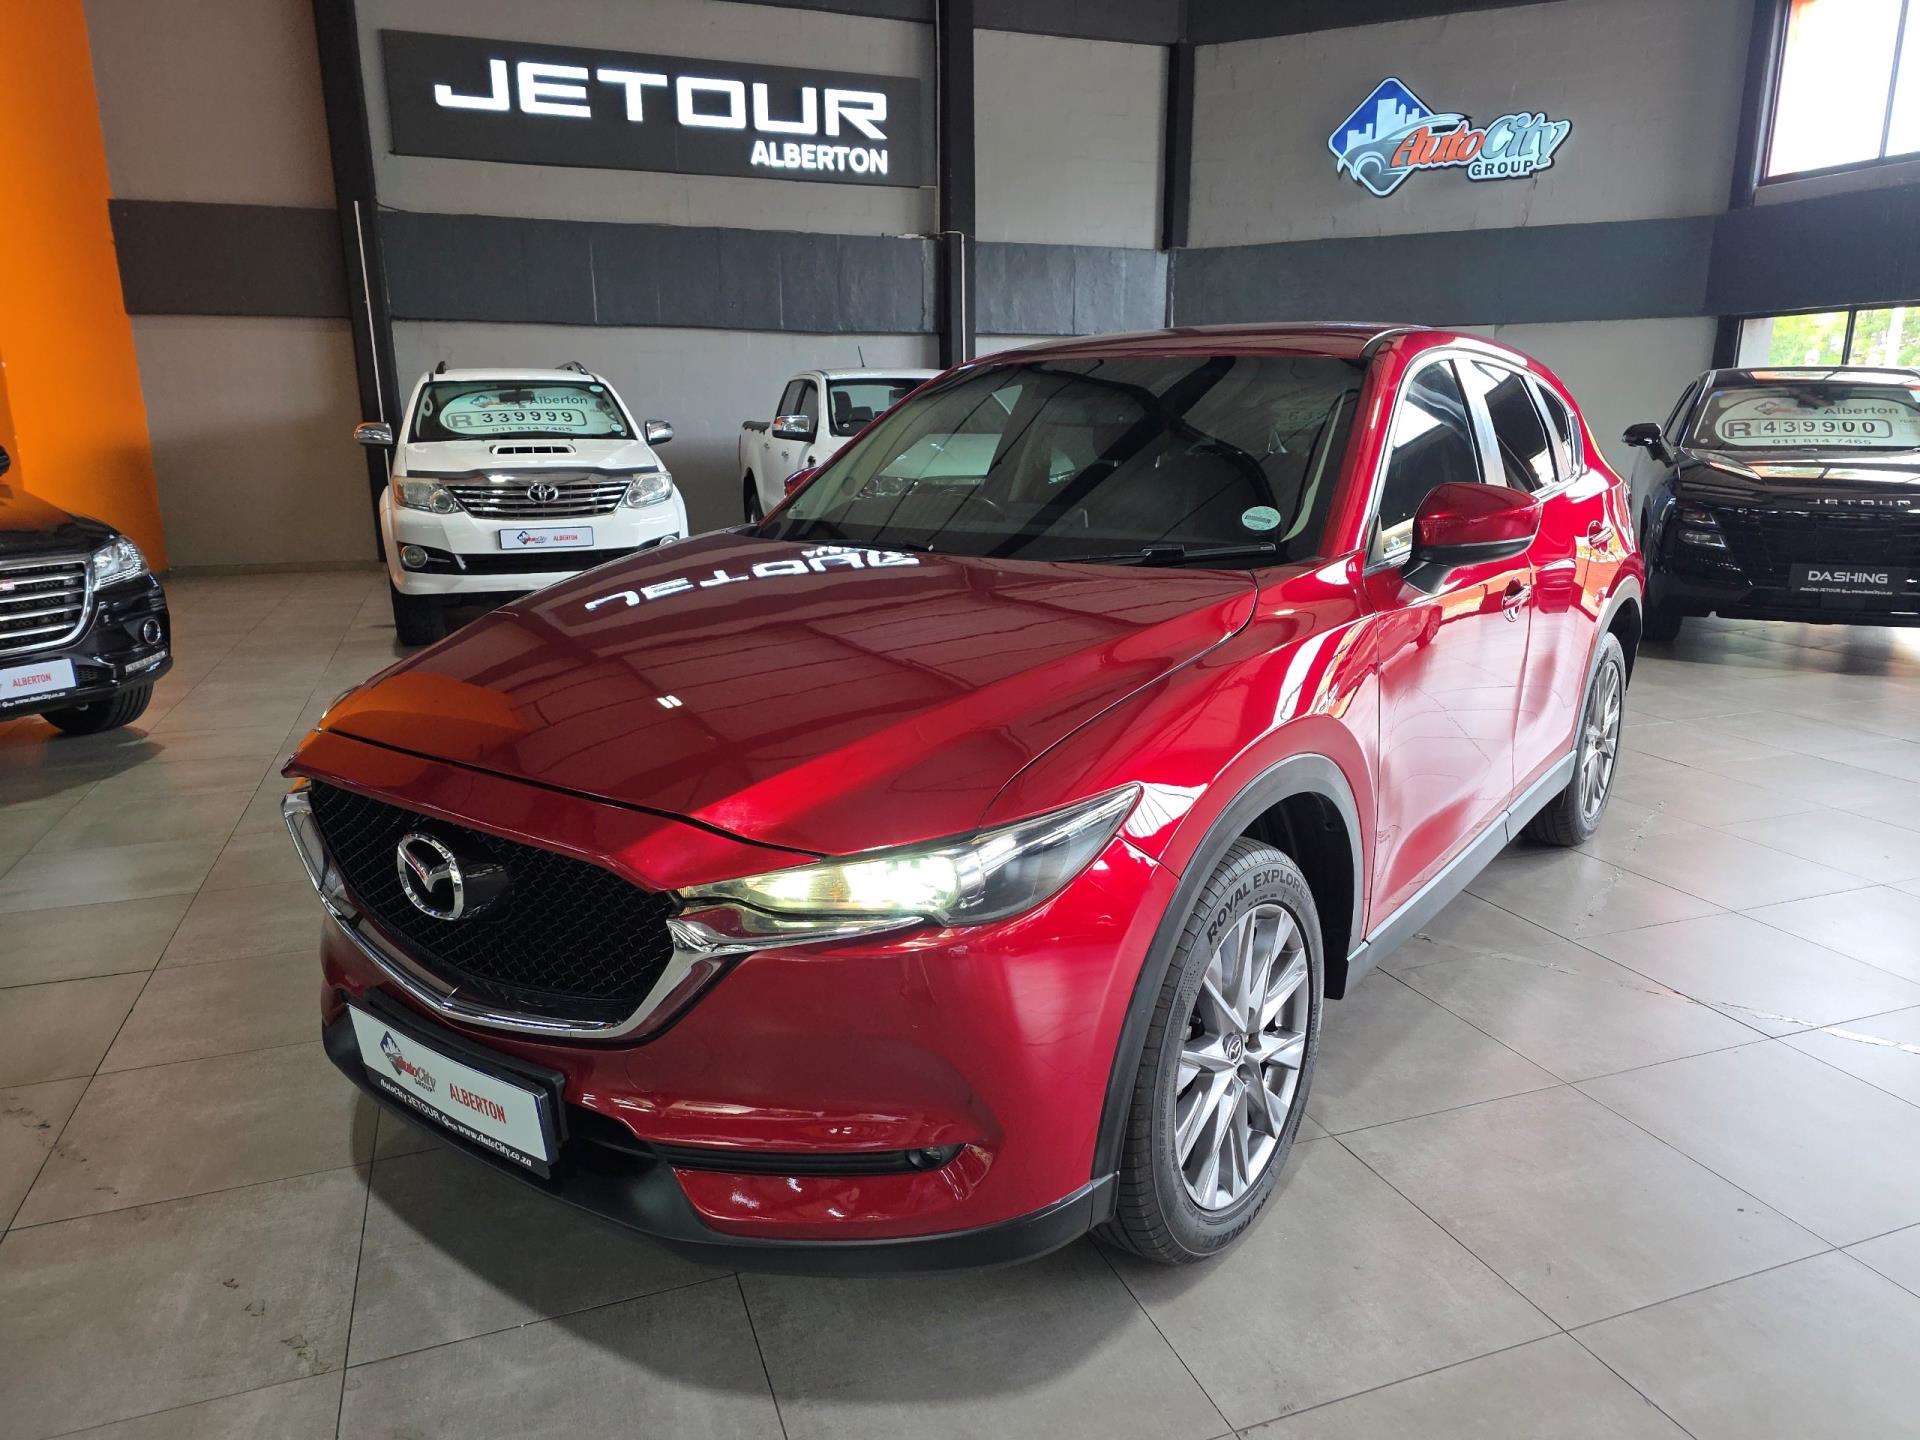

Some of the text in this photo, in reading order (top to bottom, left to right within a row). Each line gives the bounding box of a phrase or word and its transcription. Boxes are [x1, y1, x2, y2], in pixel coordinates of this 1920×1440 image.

[434, 59, 888, 140] JETOUR
[1391, 113, 1567, 168] AutoCity
[750, 140, 888, 174] ALBERTON
[1471, 160, 1534, 176] GROUP
[530, 394, 588, 405] Alberton
[1824, 406, 1898, 415] Alberton
[451, 411, 573, 427] R 339999
[1729, 421, 1875, 437] R 439900
[1808, 570, 1888, 584] DASHING
[13, 672, 52, 687] ALBERTON
[1207, 883, 1251, 945] ROYAL
[407, 1094, 441, 1121] JETOUR
[449, 1082, 507, 1124] ALBERTON
